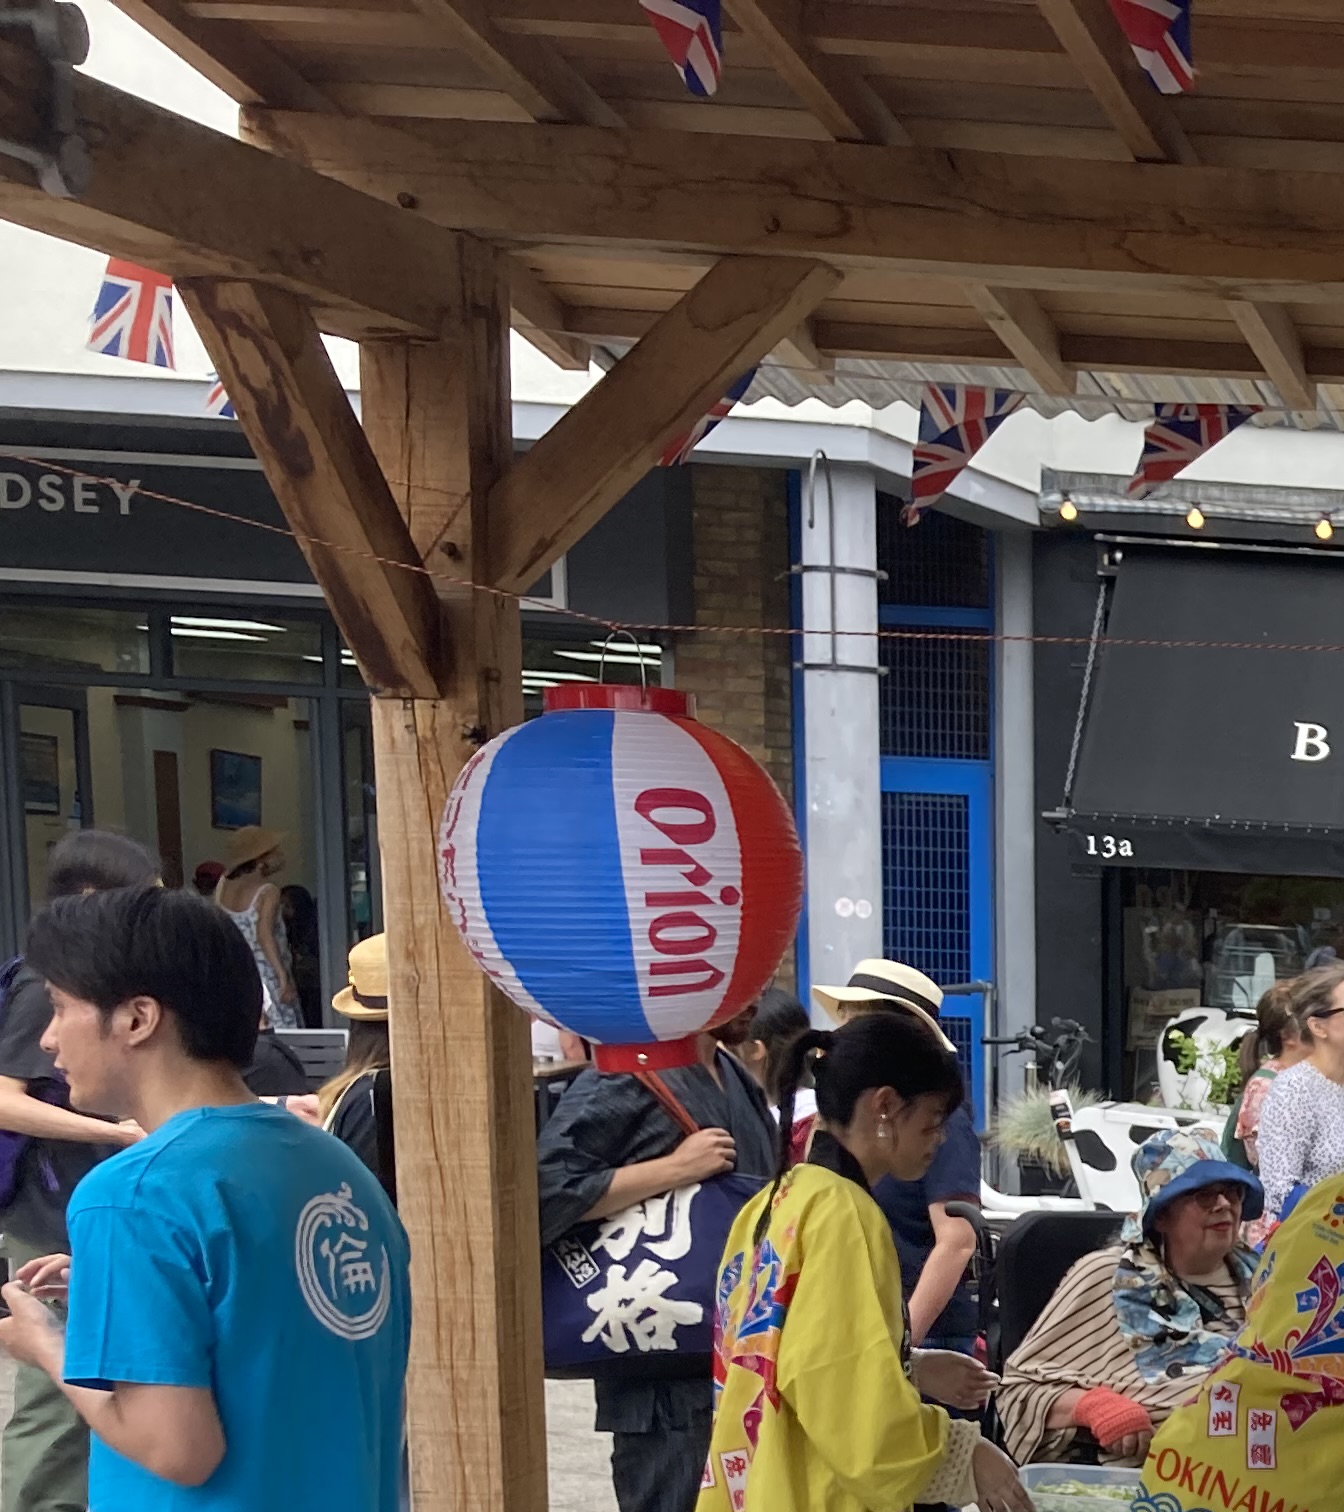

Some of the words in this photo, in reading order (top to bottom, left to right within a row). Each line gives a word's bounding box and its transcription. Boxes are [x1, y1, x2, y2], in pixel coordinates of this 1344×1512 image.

[0, 472, 141, 515] DSEY
[1084, 833, 1135, 859] 13a
[634, 787, 741, 998] Orion
